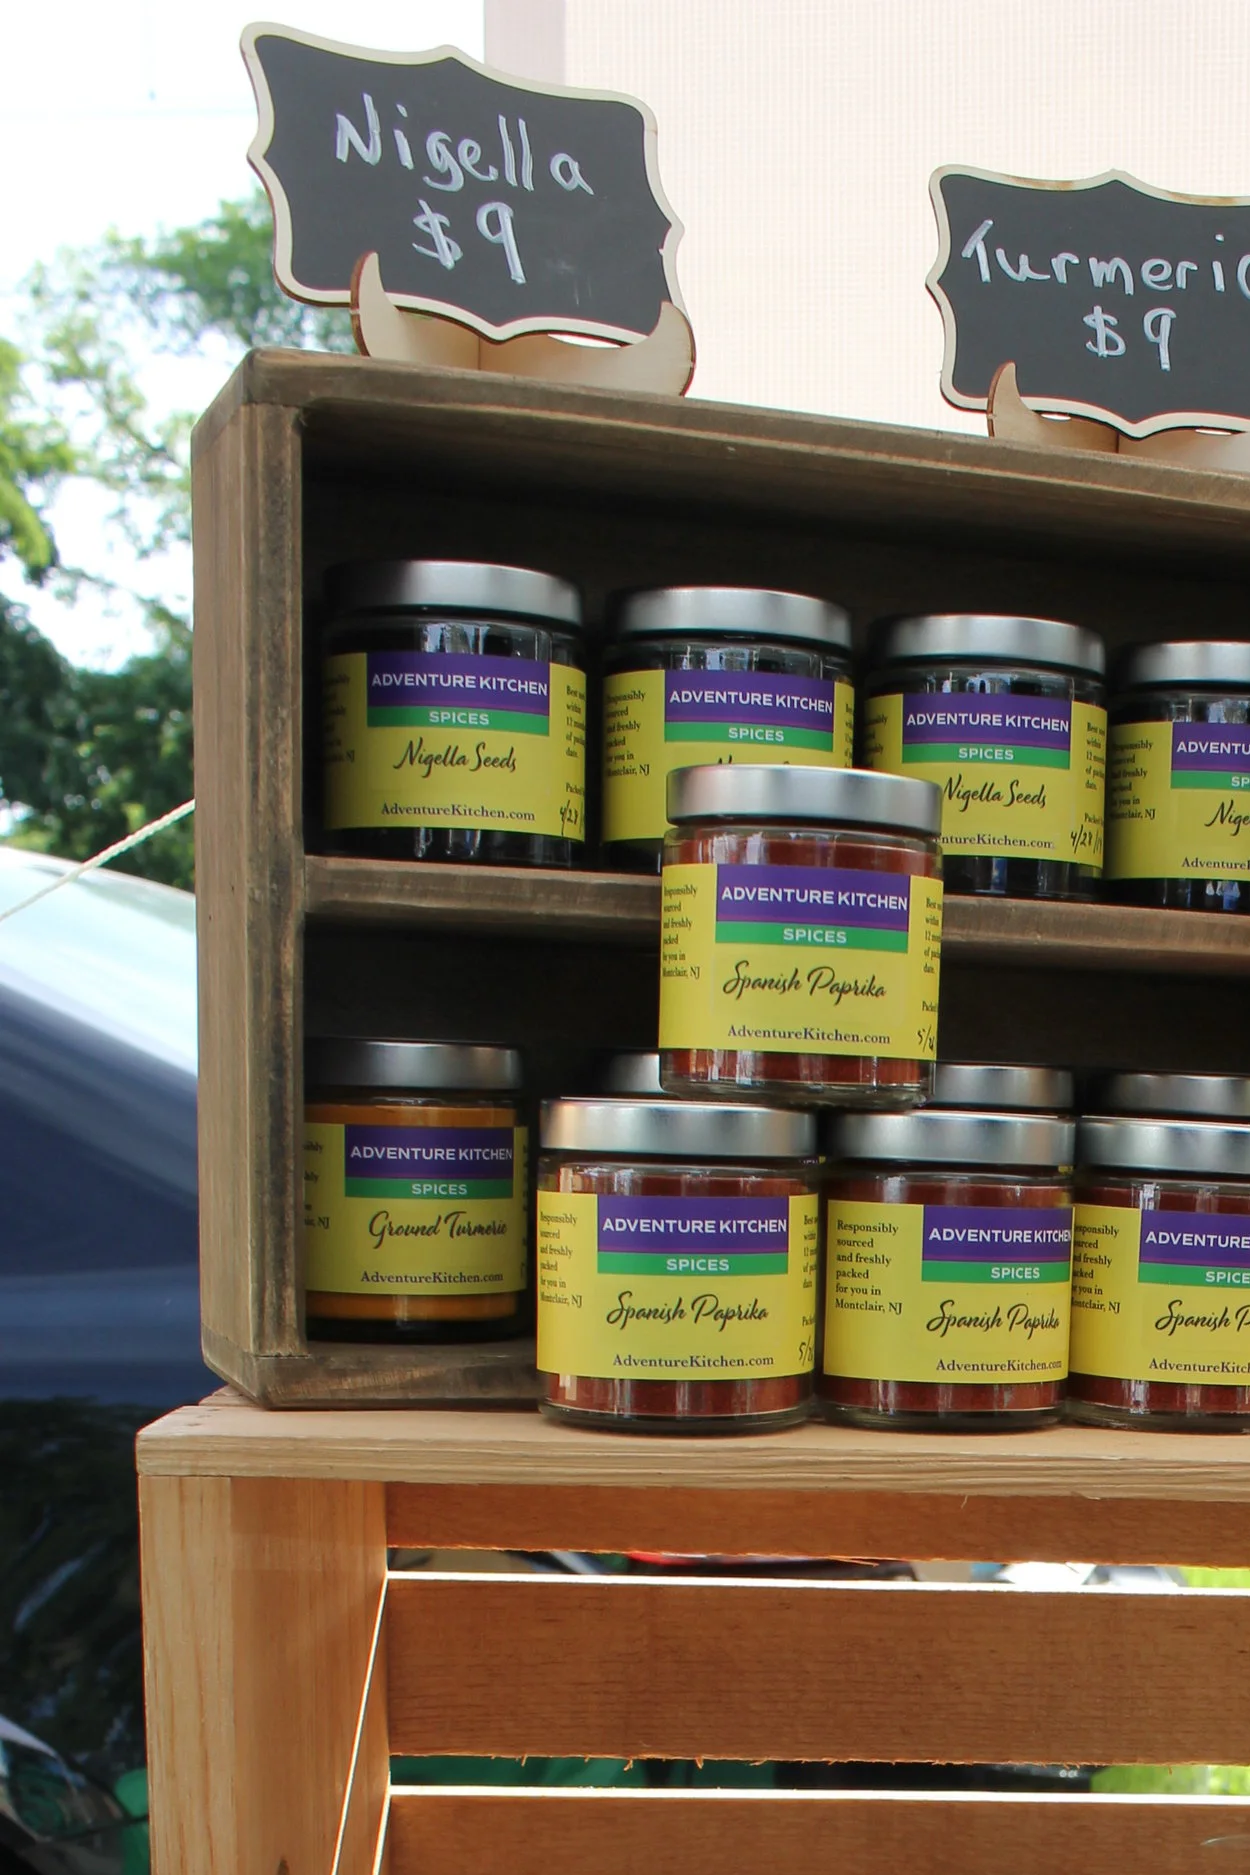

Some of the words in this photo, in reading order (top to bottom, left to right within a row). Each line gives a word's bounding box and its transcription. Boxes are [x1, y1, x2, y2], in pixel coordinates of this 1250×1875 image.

[336, 92, 594, 195] Nigella
[412, 199, 526, 285] $9
[1083, 306, 1176, 371] $9
[371, 673, 476, 688] ADVENTURE
[479, 677, 547, 696] KITCHEN
[429, 711, 490, 725] SPICES
[393, 737, 468, 778] Nigella
[470, 742, 516, 772] Seeds
[381, 802, 535, 821] AdventureKitchen.com
[722, 887, 834, 904] ADVENTURE
[838, 892, 908, 910] KITCHEN
[783, 928, 846, 943] SPICES
[723, 960, 802, 1000] Spanish
[808, 967, 886, 1005] Paprika
[728, 1026, 890, 1044] AdventureKitchen.com
[351, 1147, 455, 1160] ADVENTURE
[459, 1149, 512, 1160] KITCHEN
[412, 1184, 467, 1194] SPICES
[369, 1211, 441, 1249] Ground
[444, 1212, 507, 1238] Turmeric
[837, 1219, 899, 1236] Responsibly
[837, 1238, 873, 1248] sourced
[836, 1253, 853, 1262] and
[856, 1253, 891, 1267] freshly
[361, 1271, 503, 1283] AdventureKitchen.com
[836, 1269, 869, 1280] packed
[836, 1283, 848, 1293] for
[851, 1287, 867, 1296] you
[871, 1285, 881, 1295] in
[836, 1299, 885, 1313] Montclair,
[889, 1302, 902, 1315] NJ
[927, 1300, 1003, 1337] Spanish
[1007, 1304, 1059, 1339] Paprika
